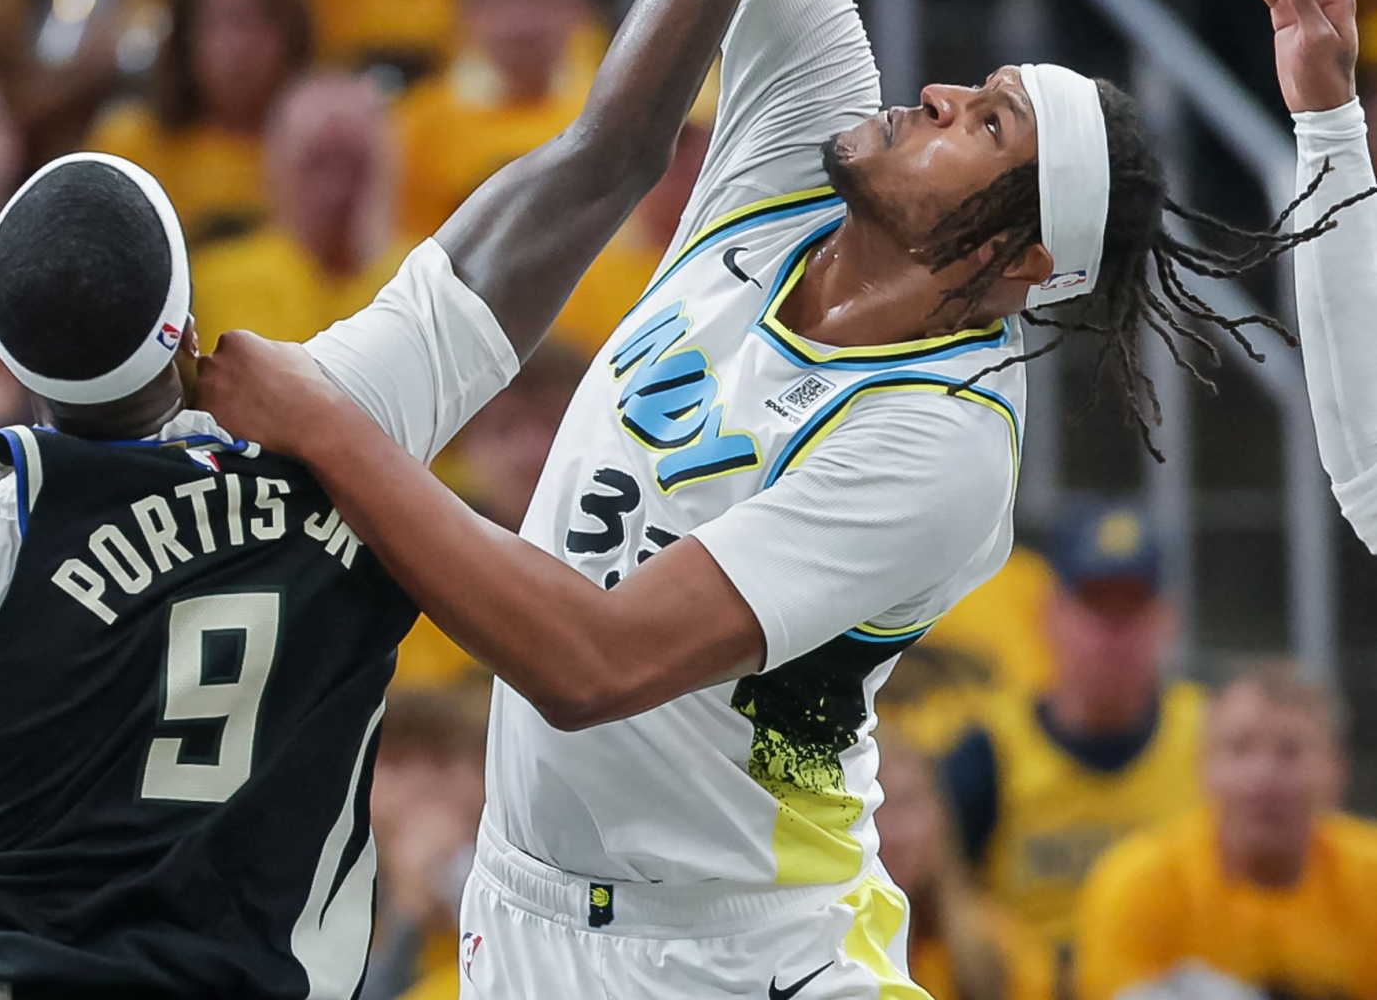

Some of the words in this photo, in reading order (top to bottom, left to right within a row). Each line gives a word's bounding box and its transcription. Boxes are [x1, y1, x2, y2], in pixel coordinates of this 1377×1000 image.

[606, 298, 763, 496] INDY
[51, 473, 291, 626] PORTIS
[140, 592, 280, 803] 9
